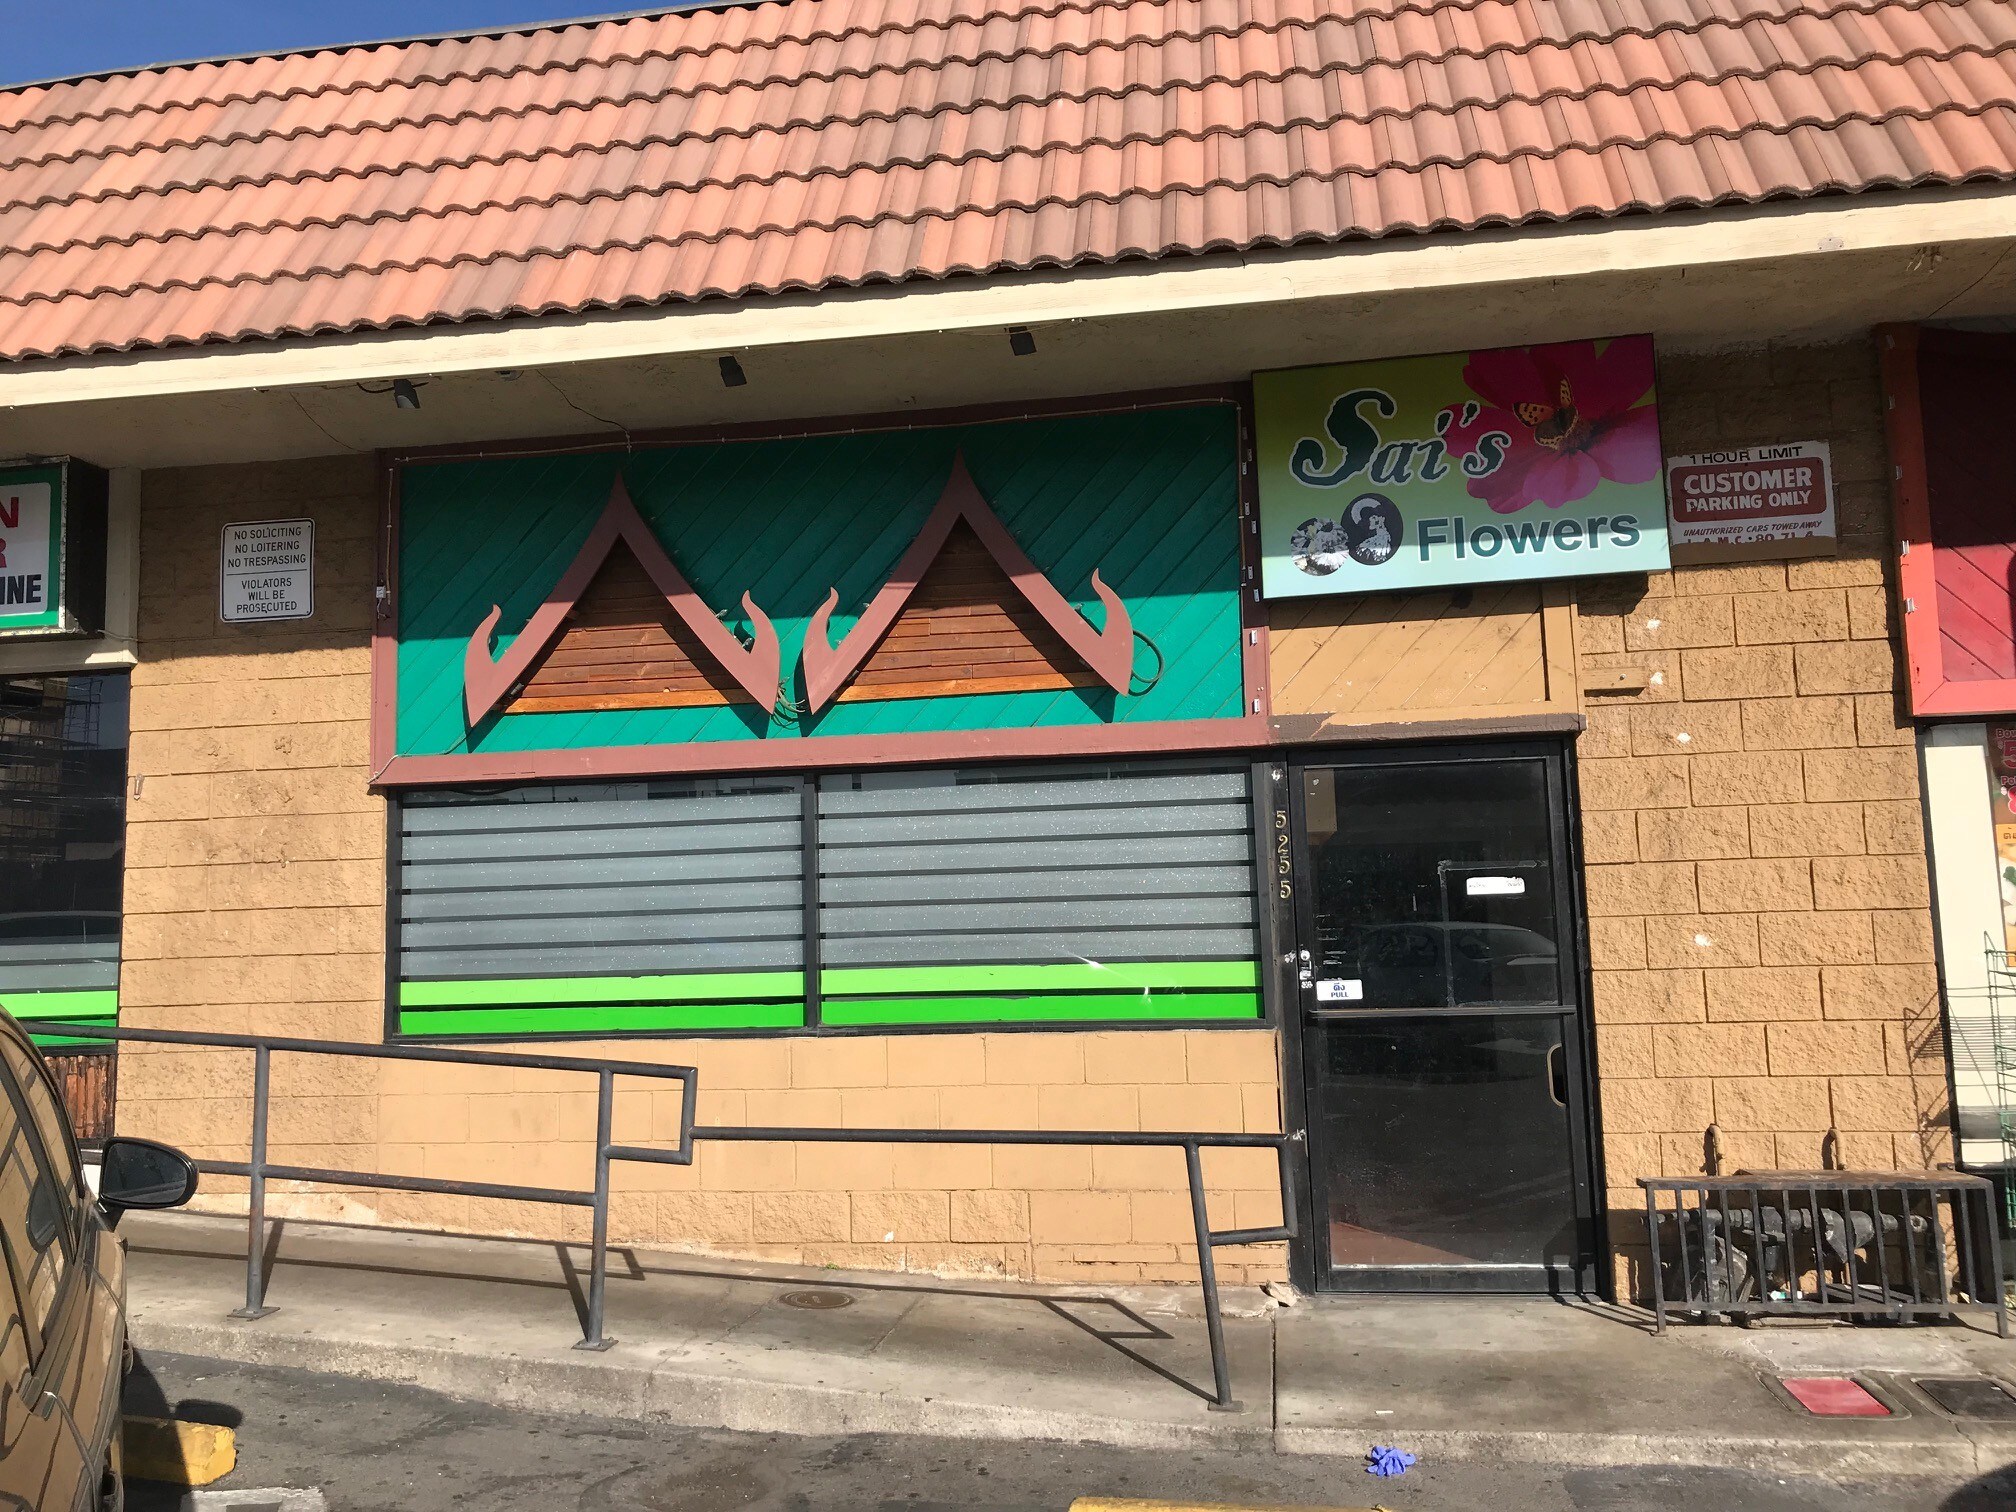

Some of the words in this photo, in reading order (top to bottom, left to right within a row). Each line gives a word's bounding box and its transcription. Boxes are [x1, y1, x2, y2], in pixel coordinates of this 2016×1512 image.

[1290, 388, 1512, 489] Sai's
[1690, 454, 1697, 465] 1
[1702, 451, 1750, 464] HOUR
[1759, 446, 1803, 460] LIMIT
[1683, 467, 1813, 495] CUSTOMER
[1686, 495, 1763, 512] PARKING
[1768, 490, 1811, 507] ONLY
[234, 531, 247, 540] NO
[249, 526, 302, 539] SOLICITING
[1683, 526, 1744, 537] UNAUTHORIZED
[1746, 524, 1769, 533] CARS
[1771, 521, 1800, 531] TOWED
[1799, 520, 1823, 530] AWAY
[1416, 512, 1642, 563] Flowers
[235, 544, 248, 554] NO
[251, 541, 300, 553] LOITERING
[228, 559, 241, 568] NO
[244, 554, 306, 567] TRESPASSING
[241, 577, 293, 590] VIOLATORS
[248, 590, 270, 601] WILL
[272, 590, 285, 600] BE
[236, 600, 298, 614] PROSECUTED
[1275, 810, 1292, 899] 5255
